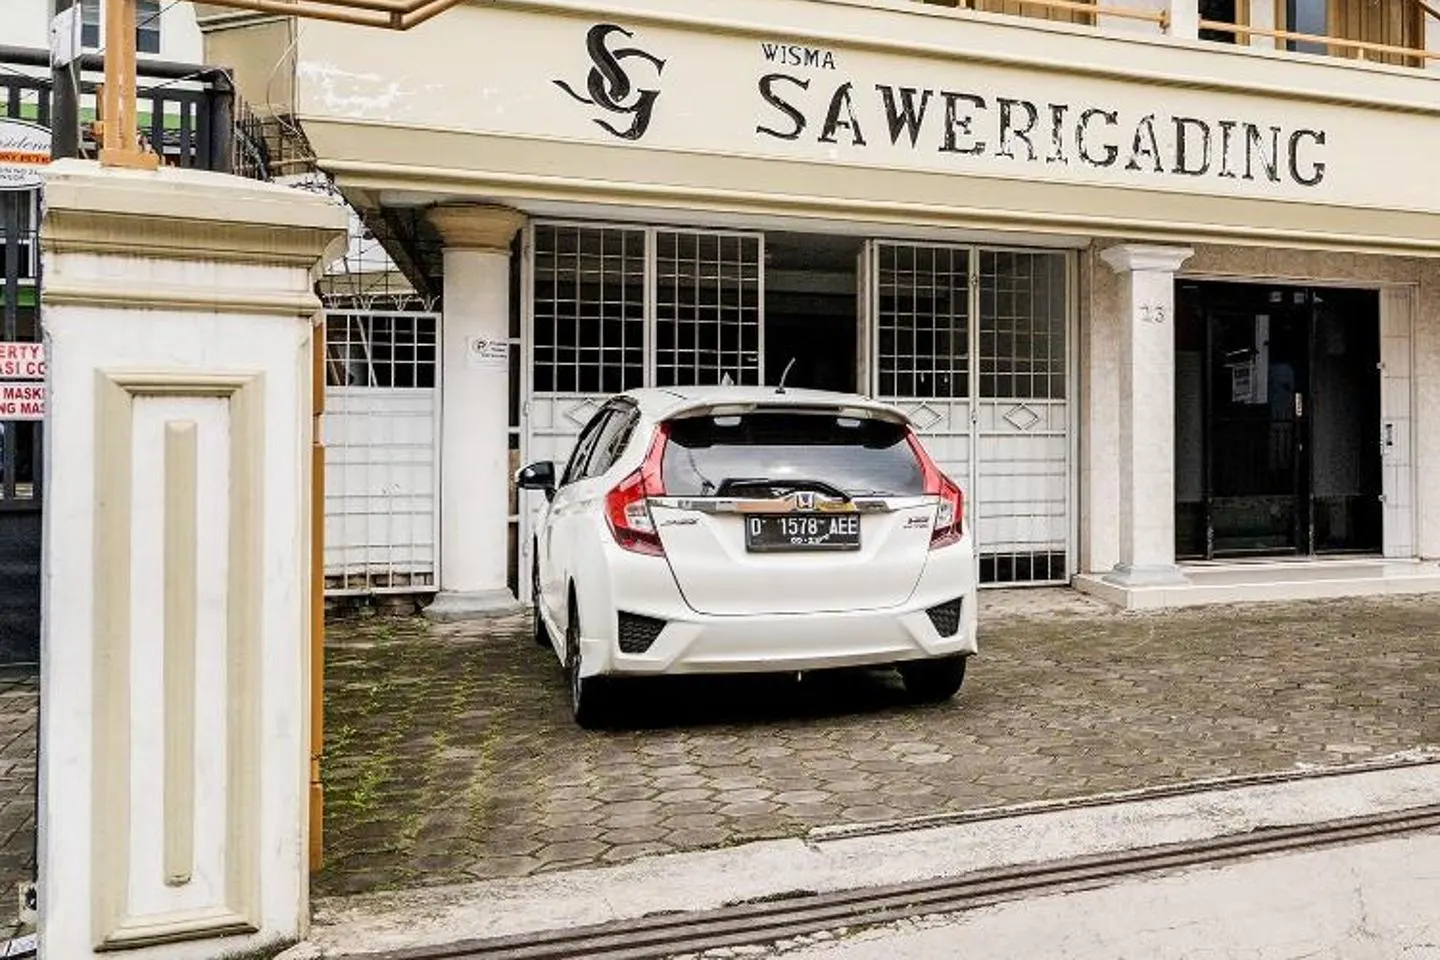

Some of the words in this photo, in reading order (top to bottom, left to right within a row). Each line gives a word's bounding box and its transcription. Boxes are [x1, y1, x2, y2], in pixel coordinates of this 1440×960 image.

[761, 43, 836, 70] WISMA
[756, 73, 1326, 186] SAWERIGADING
[750, 518, 761, 536] D
[780, 518, 818, 535] 1578
[829, 518, 857, 535] AEE
